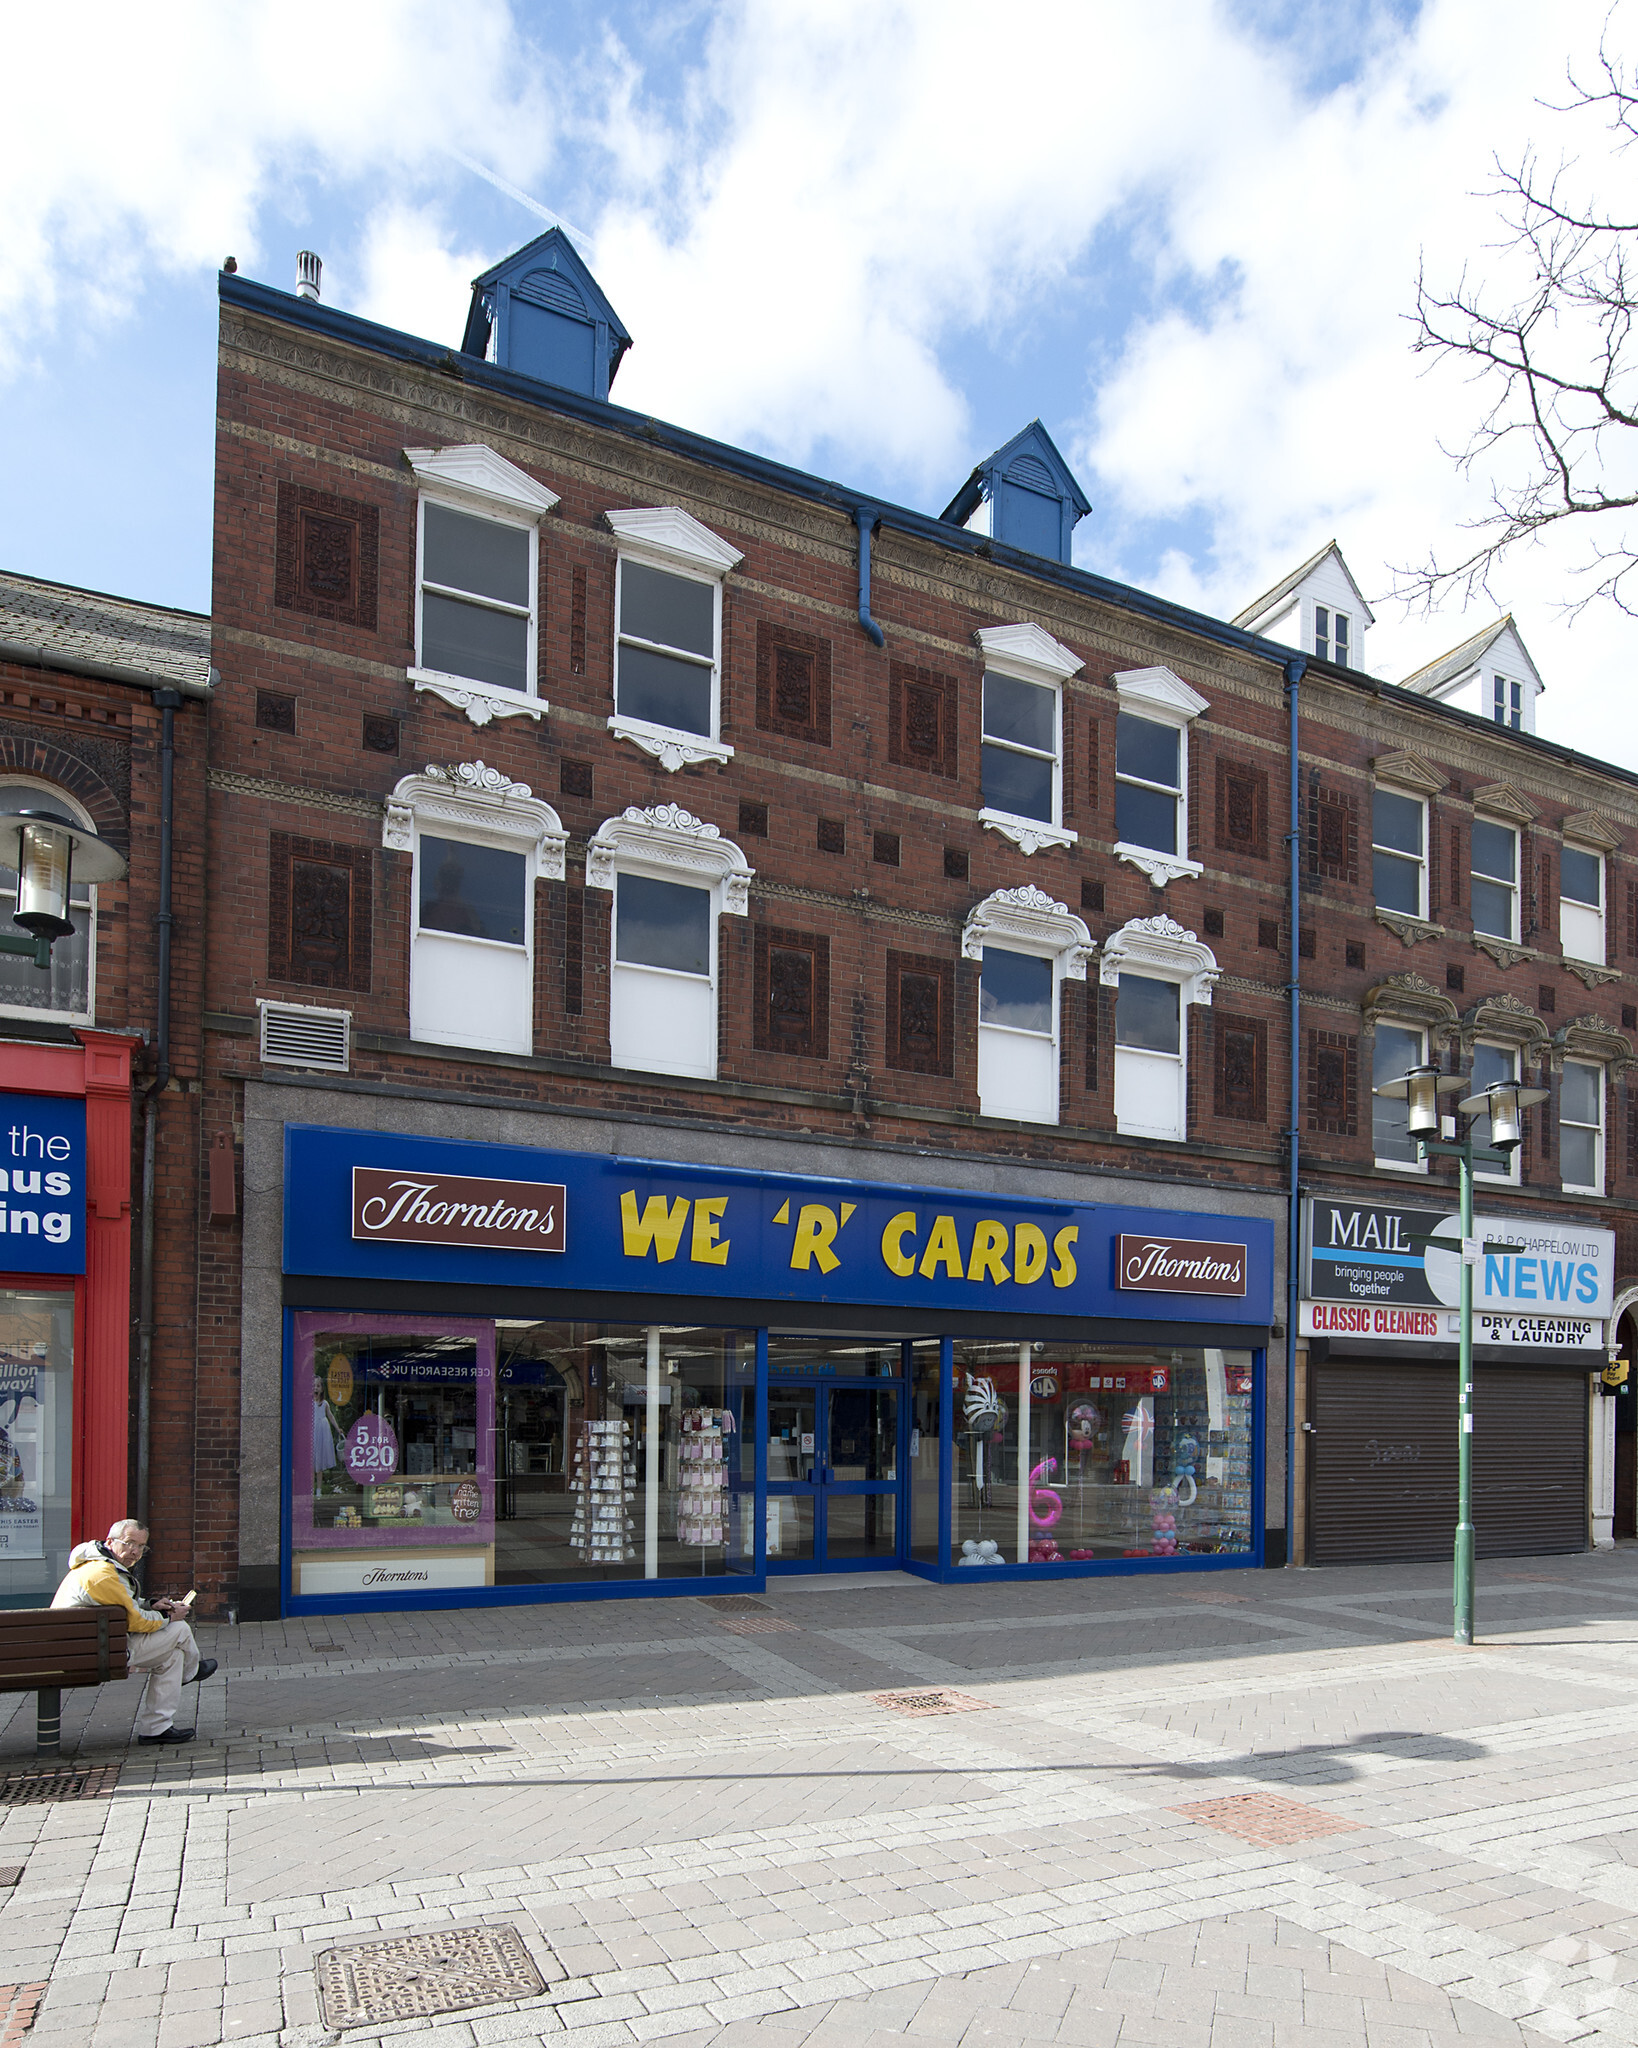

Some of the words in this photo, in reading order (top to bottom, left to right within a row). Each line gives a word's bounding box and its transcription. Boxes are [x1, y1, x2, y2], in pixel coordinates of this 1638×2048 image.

[8, 1125, 71, 1161] the
[361, 1180, 555, 1235] Thorntons
[620, 1189, 731, 1266] WE
[881, 1211, 1079, 1288] CARDS
[1329, 1209, 1411, 1252] MAIL
[1581, 1243, 1600, 1258] LTD
[1126, 1243, 1241, 1284] Thorntons
[1335, 1265, 1372, 1282] bringing
[1374, 1269, 1405, 1284] people
[1485, 1254, 1599, 1304] NEWS
[1349, 1281, 1391, 1296] together
[1312, 1305, 1371, 1332] CLASSIC
[1374, 1309, 1438, 1336] CLEANERS
[1481, 1316, 1513, 1329] DRY
[1518, 1318, 1592, 1334] CLEANING
[1490, 1329, 1501, 1341] &
[1511, 1330, 1585, 1345] LAUNDRY
[356, 1426, 369, 1445] 5
[372, 1436, 389, 1444] FOR
[350, 1445, 395, 1468] £20
[457, 1489, 479, 1499] name
[461, 1483, 476, 1492] any
[453, 1498, 480, 1508] written
[453, 1506, 480, 1519] free
[362, 1567, 429, 1586] Thorntons
